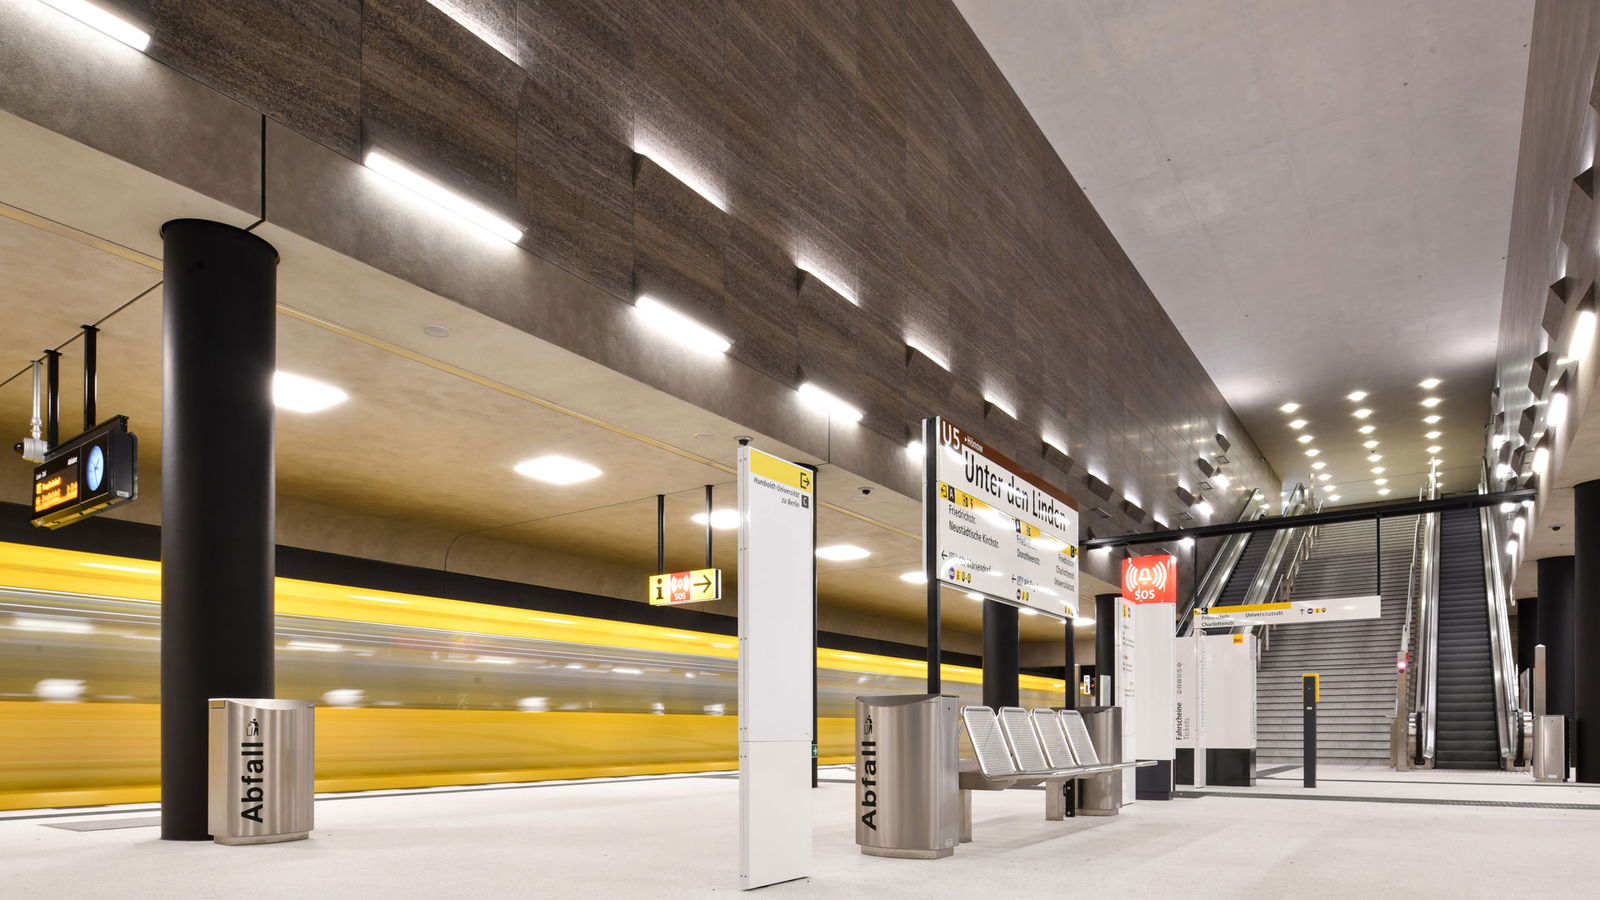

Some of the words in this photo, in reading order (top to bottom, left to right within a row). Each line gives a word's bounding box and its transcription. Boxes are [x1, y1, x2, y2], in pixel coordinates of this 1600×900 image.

[943, 420, 960, 450] U5
[965, 450, 1004, 498] Unter
[1007, 475, 1028, 512] den
[1032, 490, 1066, 532] Linden
[674, 592, 687, 601] SOS
[1135, 589, 1156, 600] SOS
[241, 742, 264, 823] Abfall
[861, 741, 877, 831] Abfall
